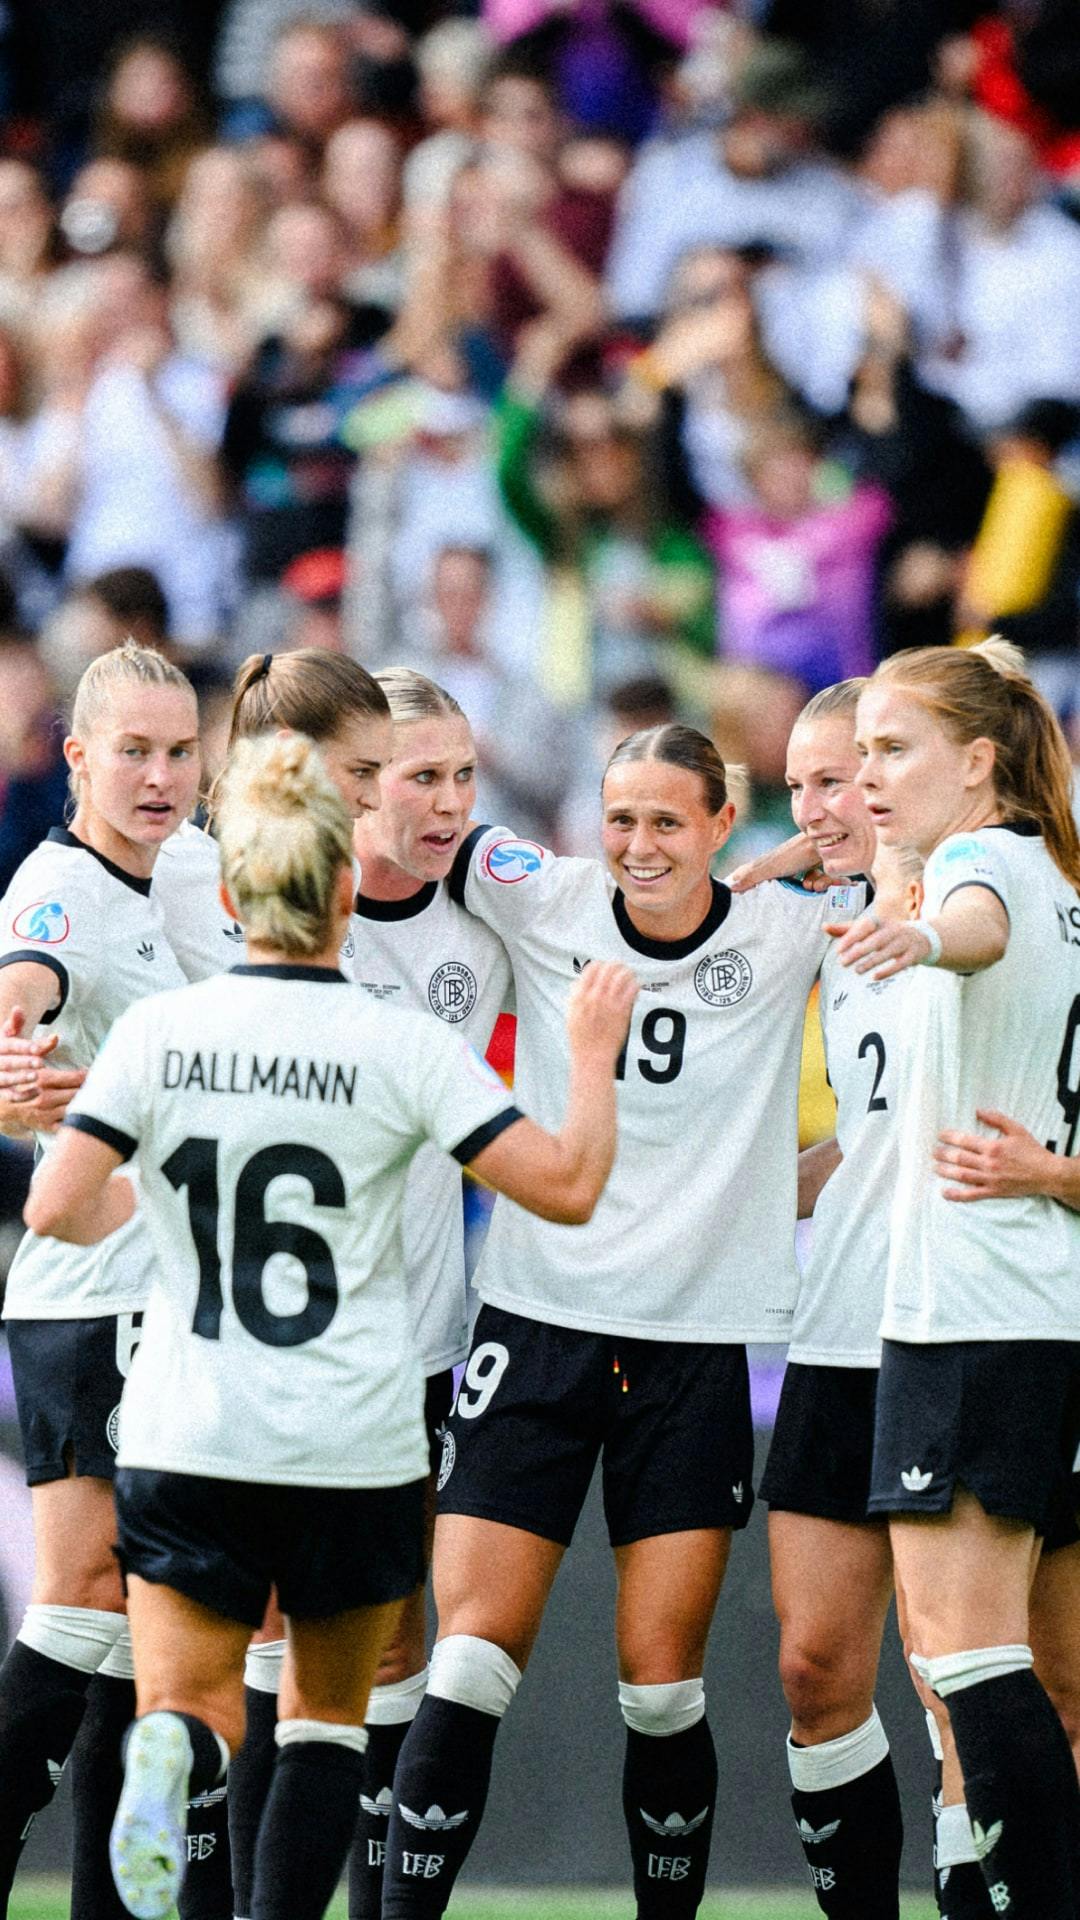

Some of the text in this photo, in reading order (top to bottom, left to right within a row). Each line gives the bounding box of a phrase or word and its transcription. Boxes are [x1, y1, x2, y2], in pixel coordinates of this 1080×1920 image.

[162, 1049, 358, 1107] DALLMANN
[159, 1137, 347, 1348] 16
[448, 1342, 510, 1419] 9
